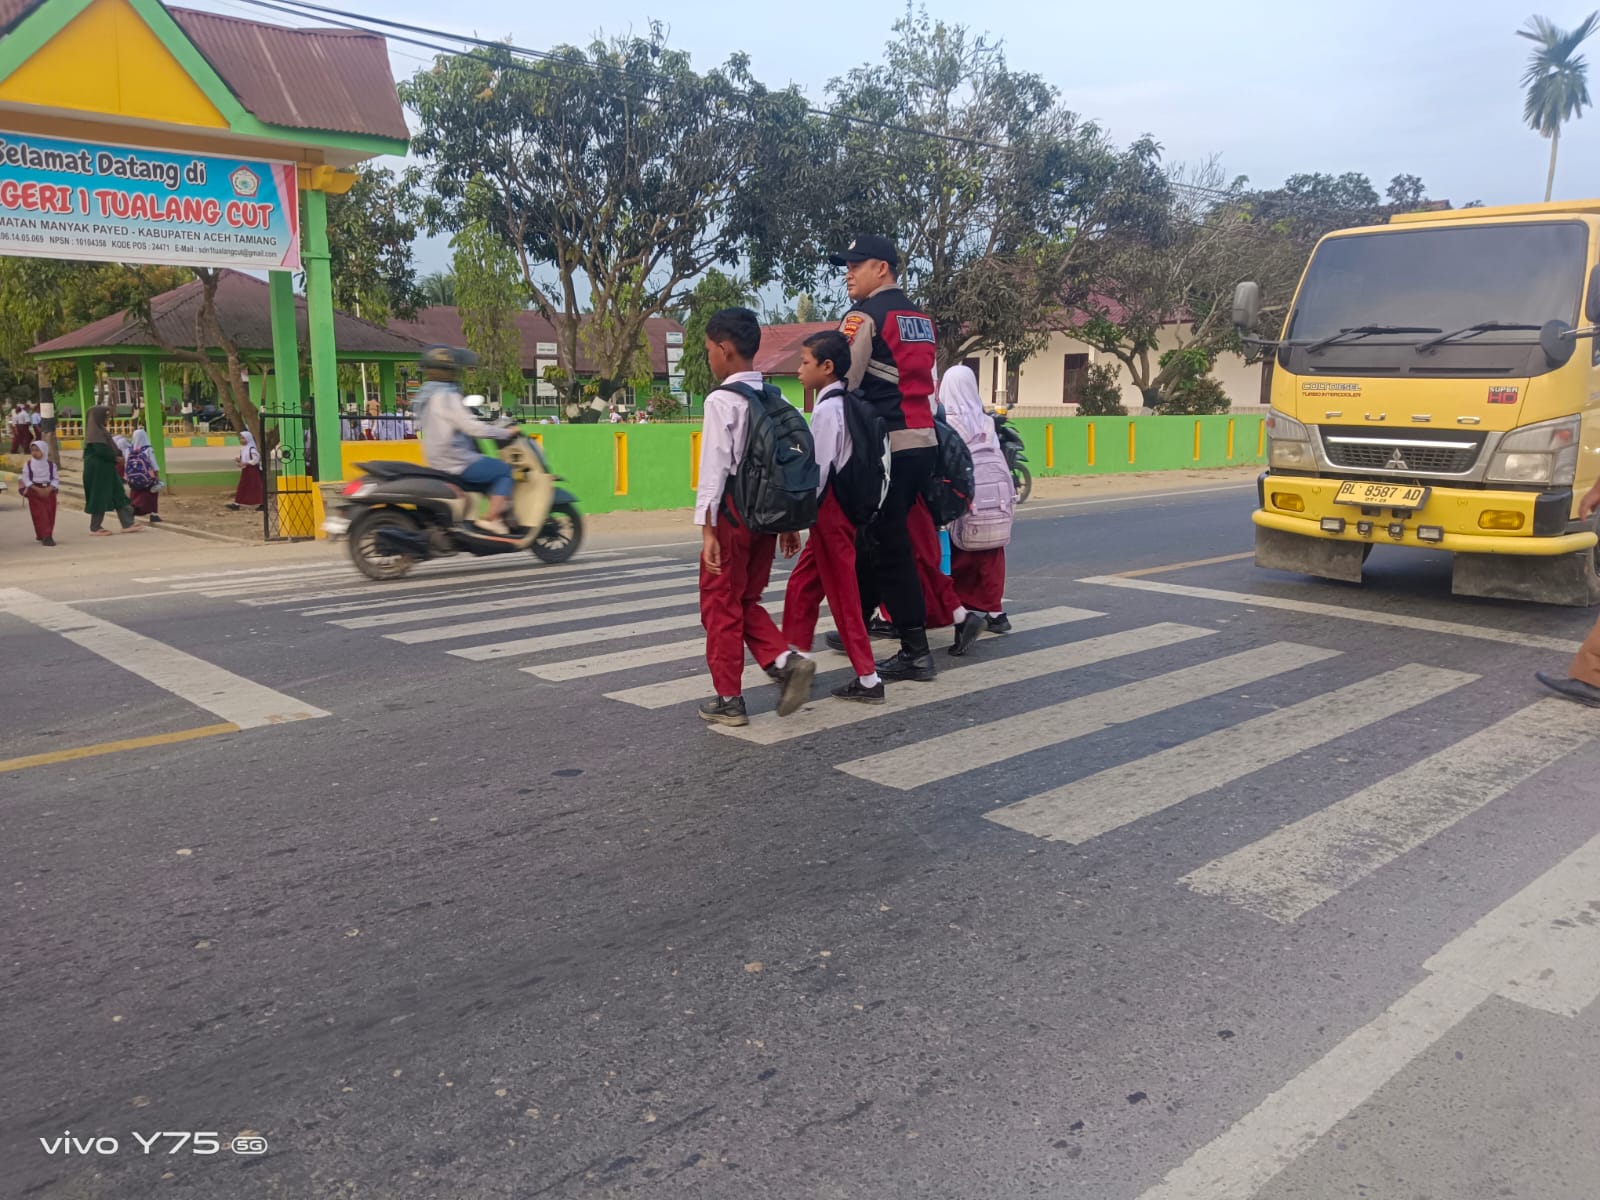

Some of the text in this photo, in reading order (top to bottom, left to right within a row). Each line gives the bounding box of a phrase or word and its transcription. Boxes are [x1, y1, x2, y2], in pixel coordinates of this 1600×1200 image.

[97, 152, 180, 190] Datang
[185, 160, 206, 184] di
[95, 190, 221, 225] TUALANG
[226, 200, 274, 228] CUT
[40, 219, 90, 233] MANYAK
[93, 224, 129, 236] PAYED
[138, 227, 201, 241] KABUPATEN
[203, 230, 231, 243] ACEH
[234, 233, 278, 246] TAMIANG
[49, 236, 70, 246] NPSN
[111, 240, 131, 250] KODE
[132, 241, 147, 251] POS
[1488, 392, 1518, 404] HD
[1325, 411, 1480, 425] FUSO
[1341, 483, 1355, 495] BL
[1364, 485, 1398, 499] 8587
[1402, 488, 1421, 501] AD
